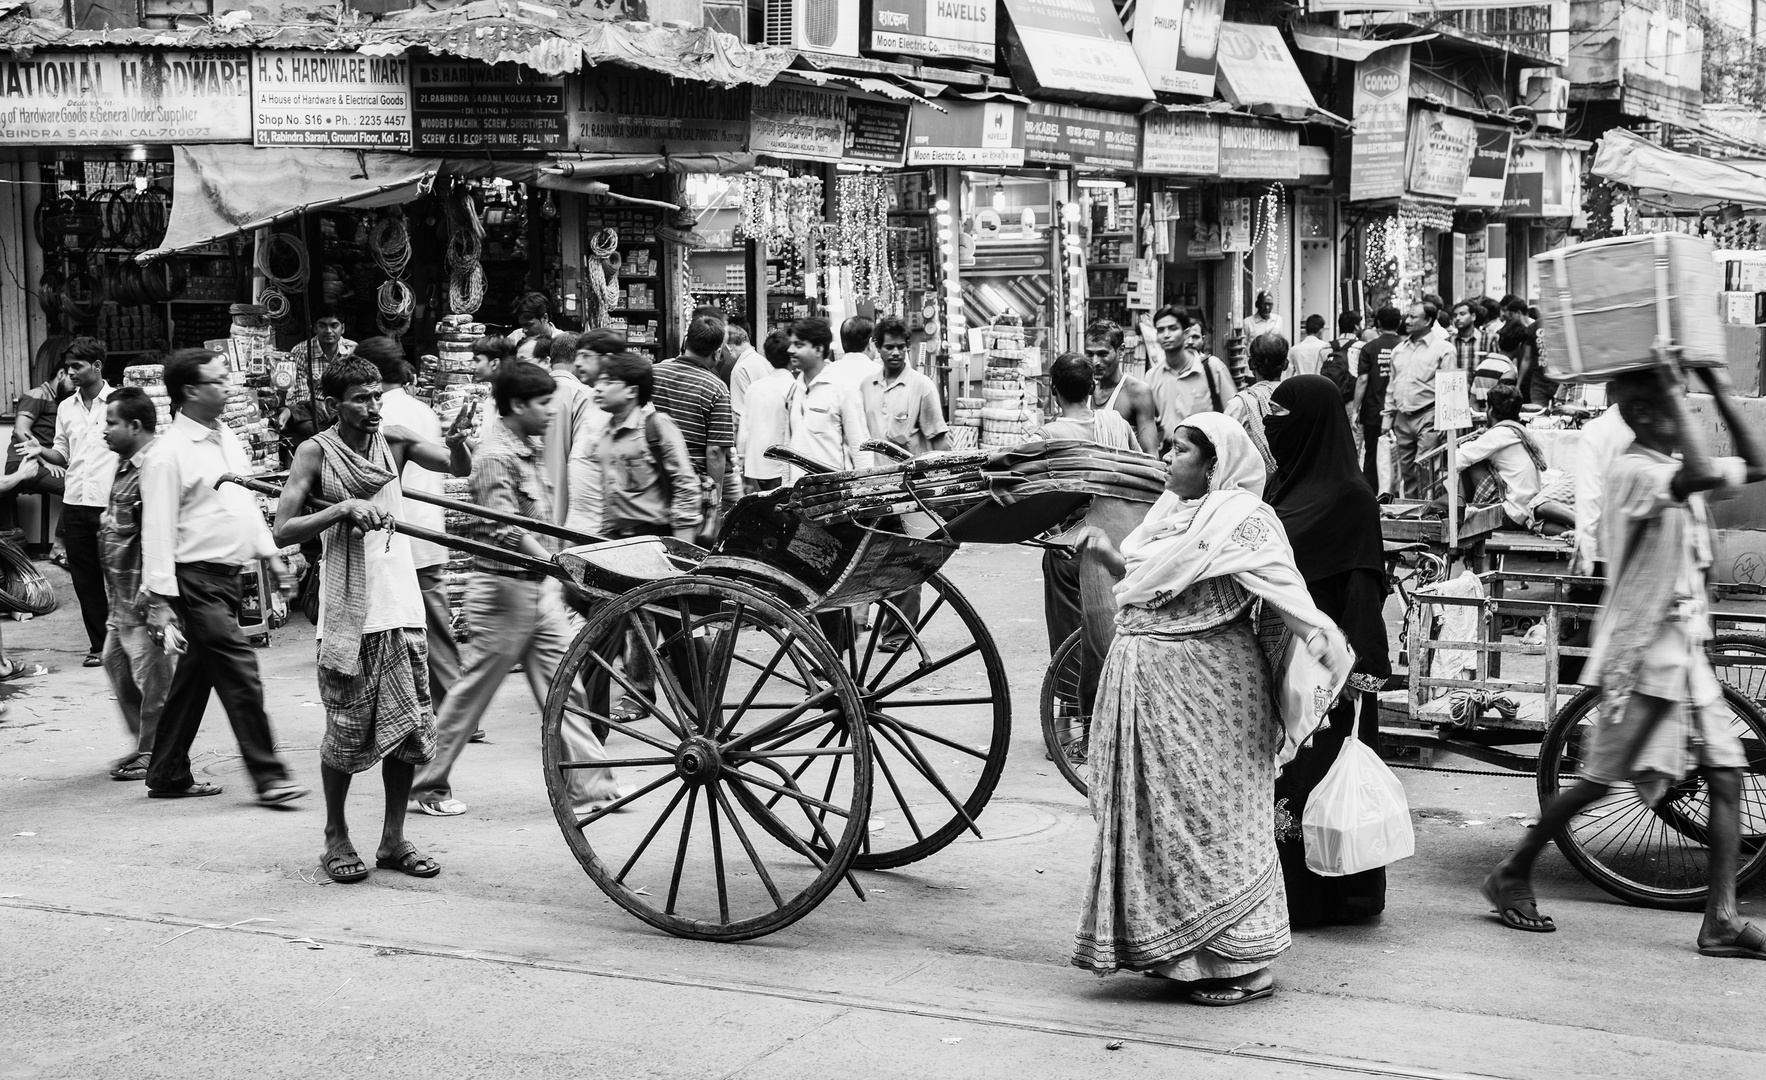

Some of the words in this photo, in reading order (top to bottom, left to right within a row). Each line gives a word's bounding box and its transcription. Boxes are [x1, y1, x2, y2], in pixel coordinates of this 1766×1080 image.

[937, 1, 986, 22] HAVELLS
[1154, 16, 1177, 30] PHILIPS
[876, 35, 897, 47] Moon
[898, 37, 926, 51] Electric
[928, 41, 940, 52] Co.
[258, 57, 271, 82] H.
[276, 57, 288, 83] S.
[292, 57, 366, 83] HARDWARE
[370, 58, 407, 83] MART
[120, 60, 248, 97] HRDWARE
[261, 95, 266, 103] A
[269, 95, 291, 104] House
[294, 95, 301, 104] of
[302, 95, 336, 105] Hardware
[339, 96, 343, 105] &
[345, 95, 378, 105] Electrical
[380, 95, 404, 105] Goods
[8, 106, 17, 123] of
[19, 107, 60, 124] Hardware
[61, 106, 87, 123] Goods
[90, 111, 96, 122] &
[96, 106, 130, 123] General
[131, 106, 155, 123] Order
[157, 105, 198, 126] Supplier
[258, 114, 283, 126] Shop
[286, 115, 302, 125] No.
[304, 115, 322, 125] S16
[335, 115, 350, 125] Ph.
[359, 115, 382, 126] 2235
[384, 115, 406, 126] 4457
[420, 118, 447, 128] WOODEN
[454, 119, 484, 128] MACHIN
[258, 131, 270, 143] 21,
[271, 131, 304, 143] Rabindra
[305, 131, 330, 144] Sarani,
[331, 131, 358, 143] Ground
[359, 132, 381, 144] Floor,
[382, 133, 394, 143] Kol
[400, 133, 409, 143] 73
[591, 124, 624, 138] RABINDRA
[988, 132, 1008, 140] HAVELLS
[1222, 126, 1260, 150] HINDUSTAN
[522, 134, 542, 144] FULL
[913, 150, 930, 161] Moon
[932, 150, 955, 161] Electric
[956, 151, 967, 161] Co.
